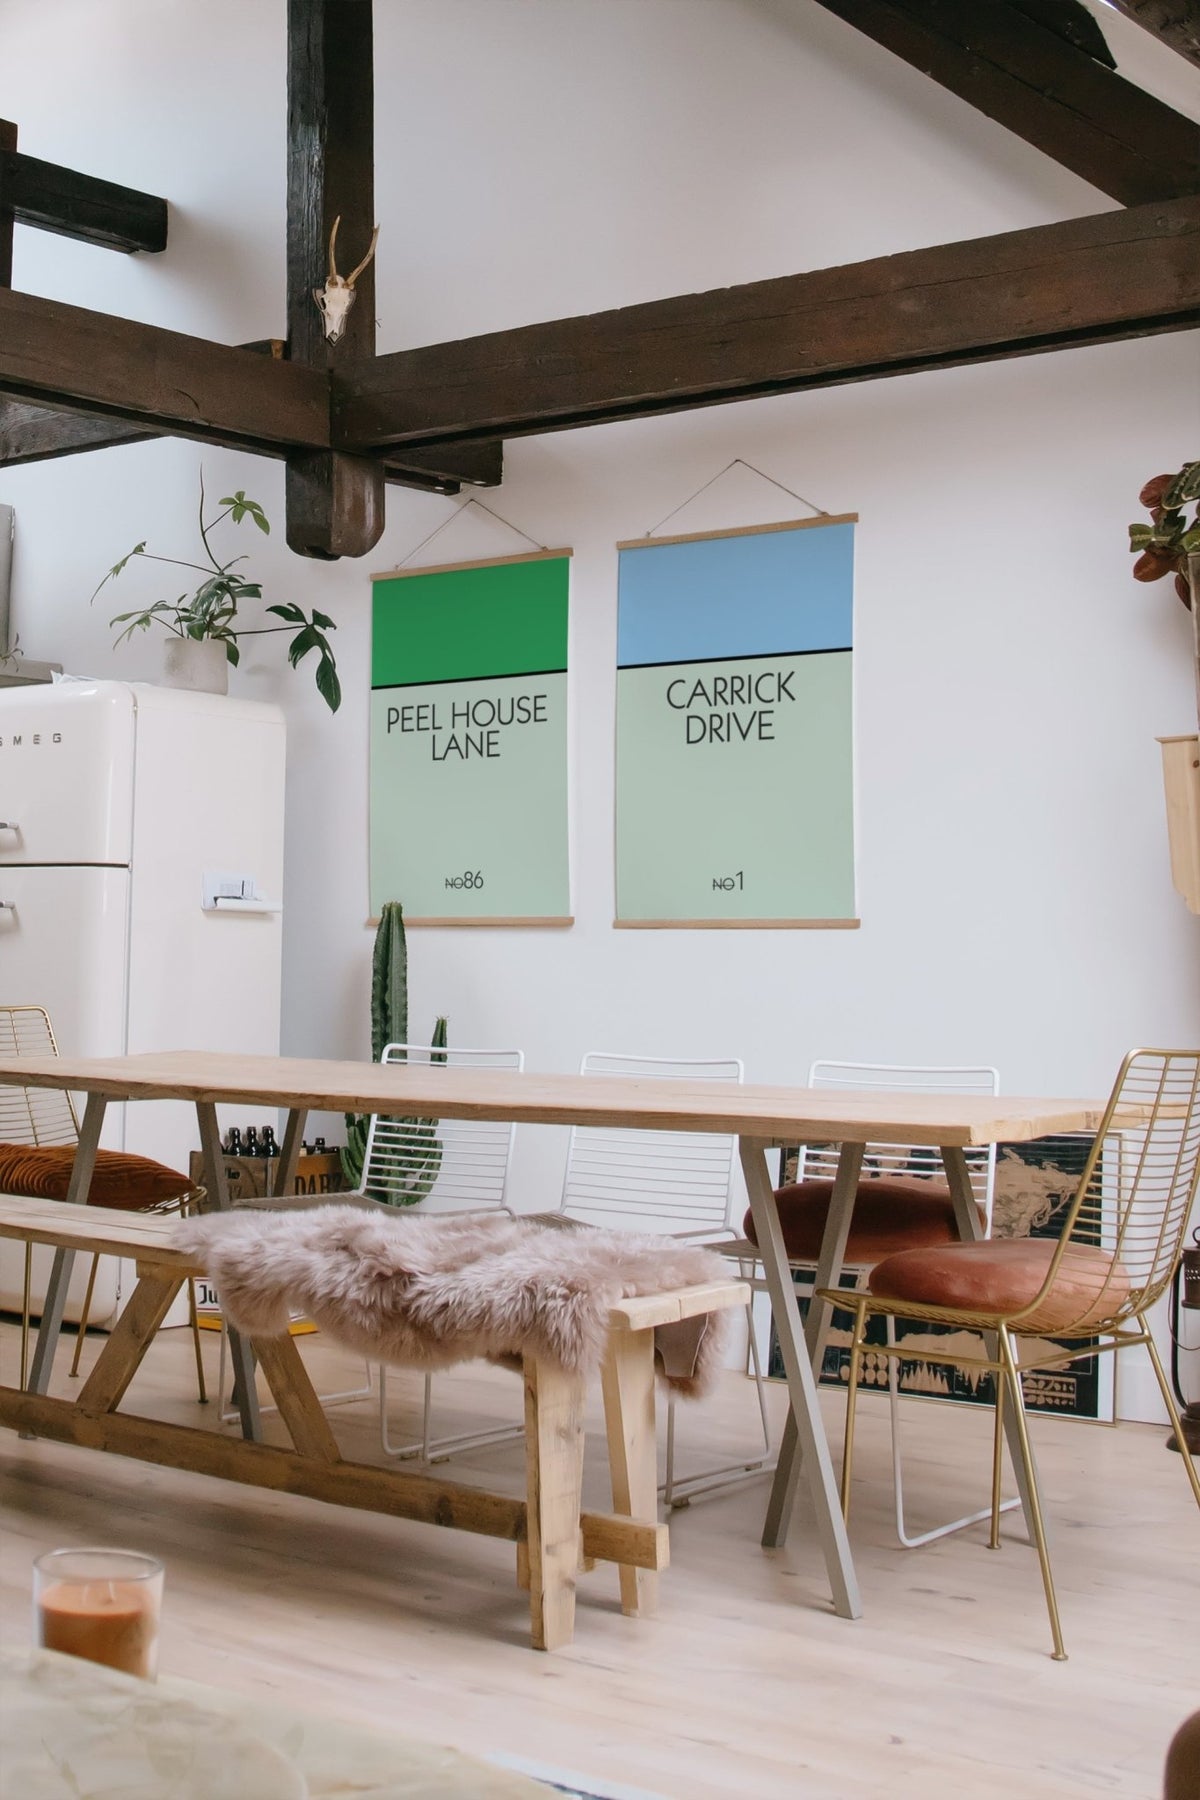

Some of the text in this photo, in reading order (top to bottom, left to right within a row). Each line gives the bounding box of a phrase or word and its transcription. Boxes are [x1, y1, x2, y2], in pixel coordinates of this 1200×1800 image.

[666, 671, 796, 709] CARRICK
[387, 694, 548, 734] PEEL HOUSE
[686, 710, 775, 744] DRIVE
[432, 730, 501, 761] LANE
